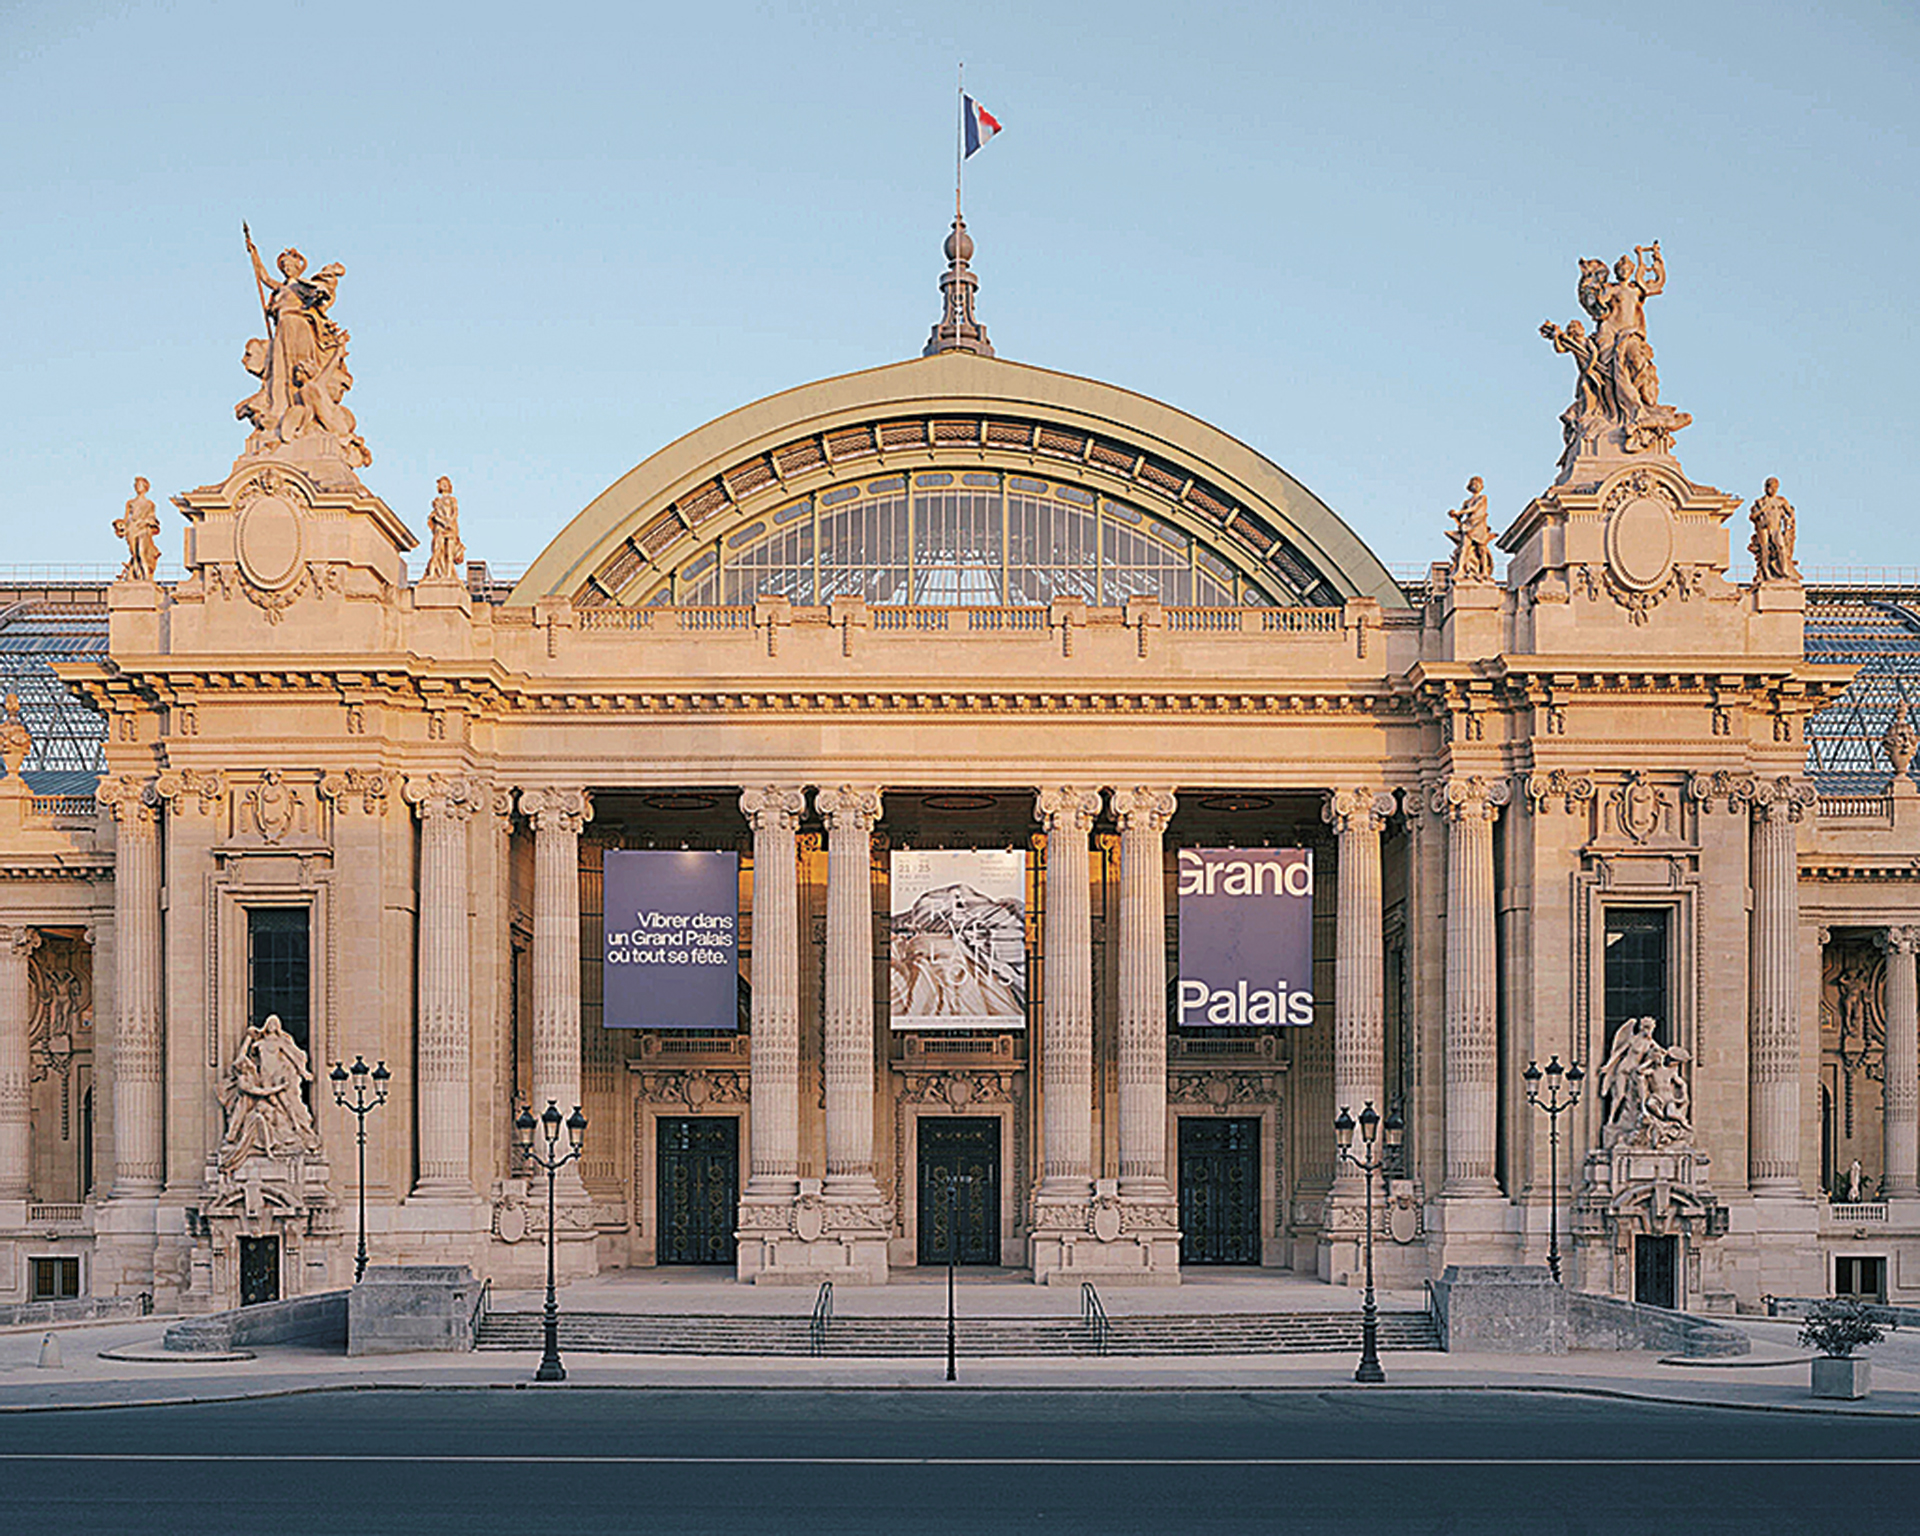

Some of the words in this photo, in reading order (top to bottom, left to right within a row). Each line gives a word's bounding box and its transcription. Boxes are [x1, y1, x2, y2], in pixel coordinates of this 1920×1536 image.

[1178, 850, 1313, 896] Grand
[638, 912, 690, 928] Vibrer
[692, 914, 733, 928] dans
[608, 933, 629, 945] un
[631, 930, 683, 946] Grand
[686, 931, 733, 946] Palais
[608, 948, 630, 963] où
[632, 949, 666, 963] tout
[668, 950, 689, 963] se
[692, 948, 728, 964] fête.
[1178, 980, 1314, 1025] Palais
